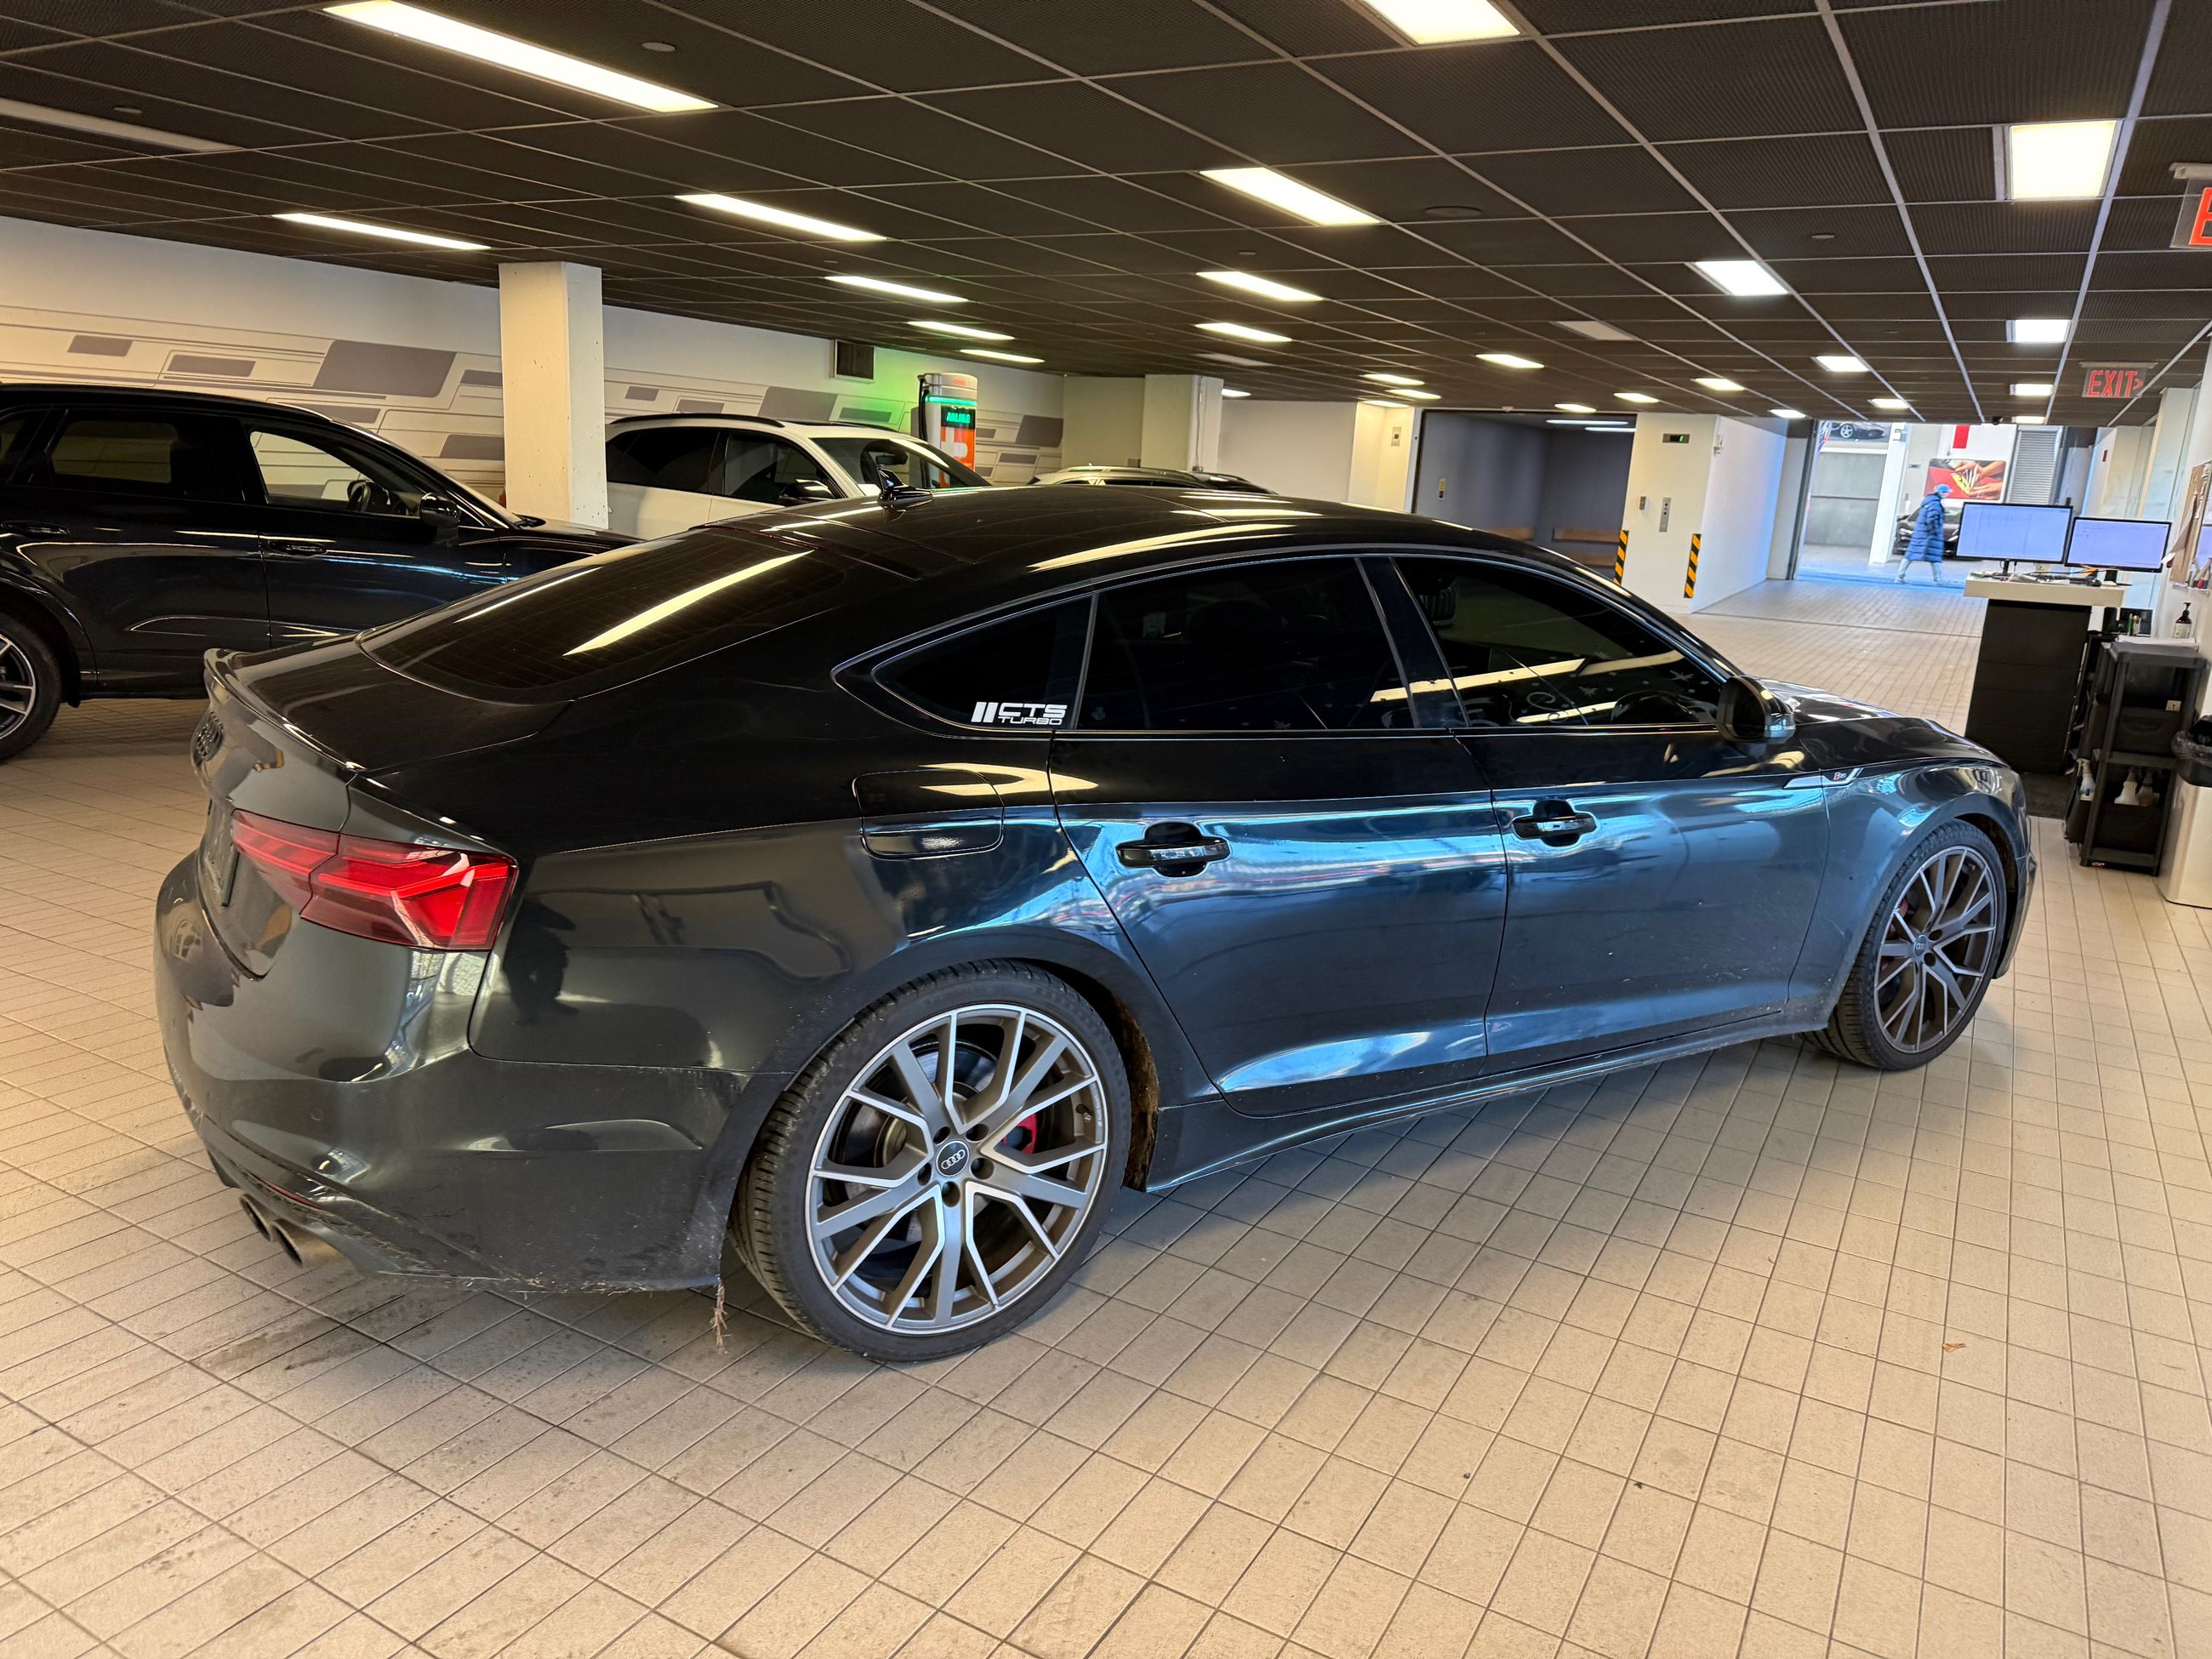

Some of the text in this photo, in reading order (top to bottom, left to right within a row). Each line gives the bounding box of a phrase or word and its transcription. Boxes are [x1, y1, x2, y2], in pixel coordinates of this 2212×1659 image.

[2087, 369, 2138, 398] EXIT
[998, 702, 1068, 718] CTS
[997, 715, 1063, 726] TURBO
